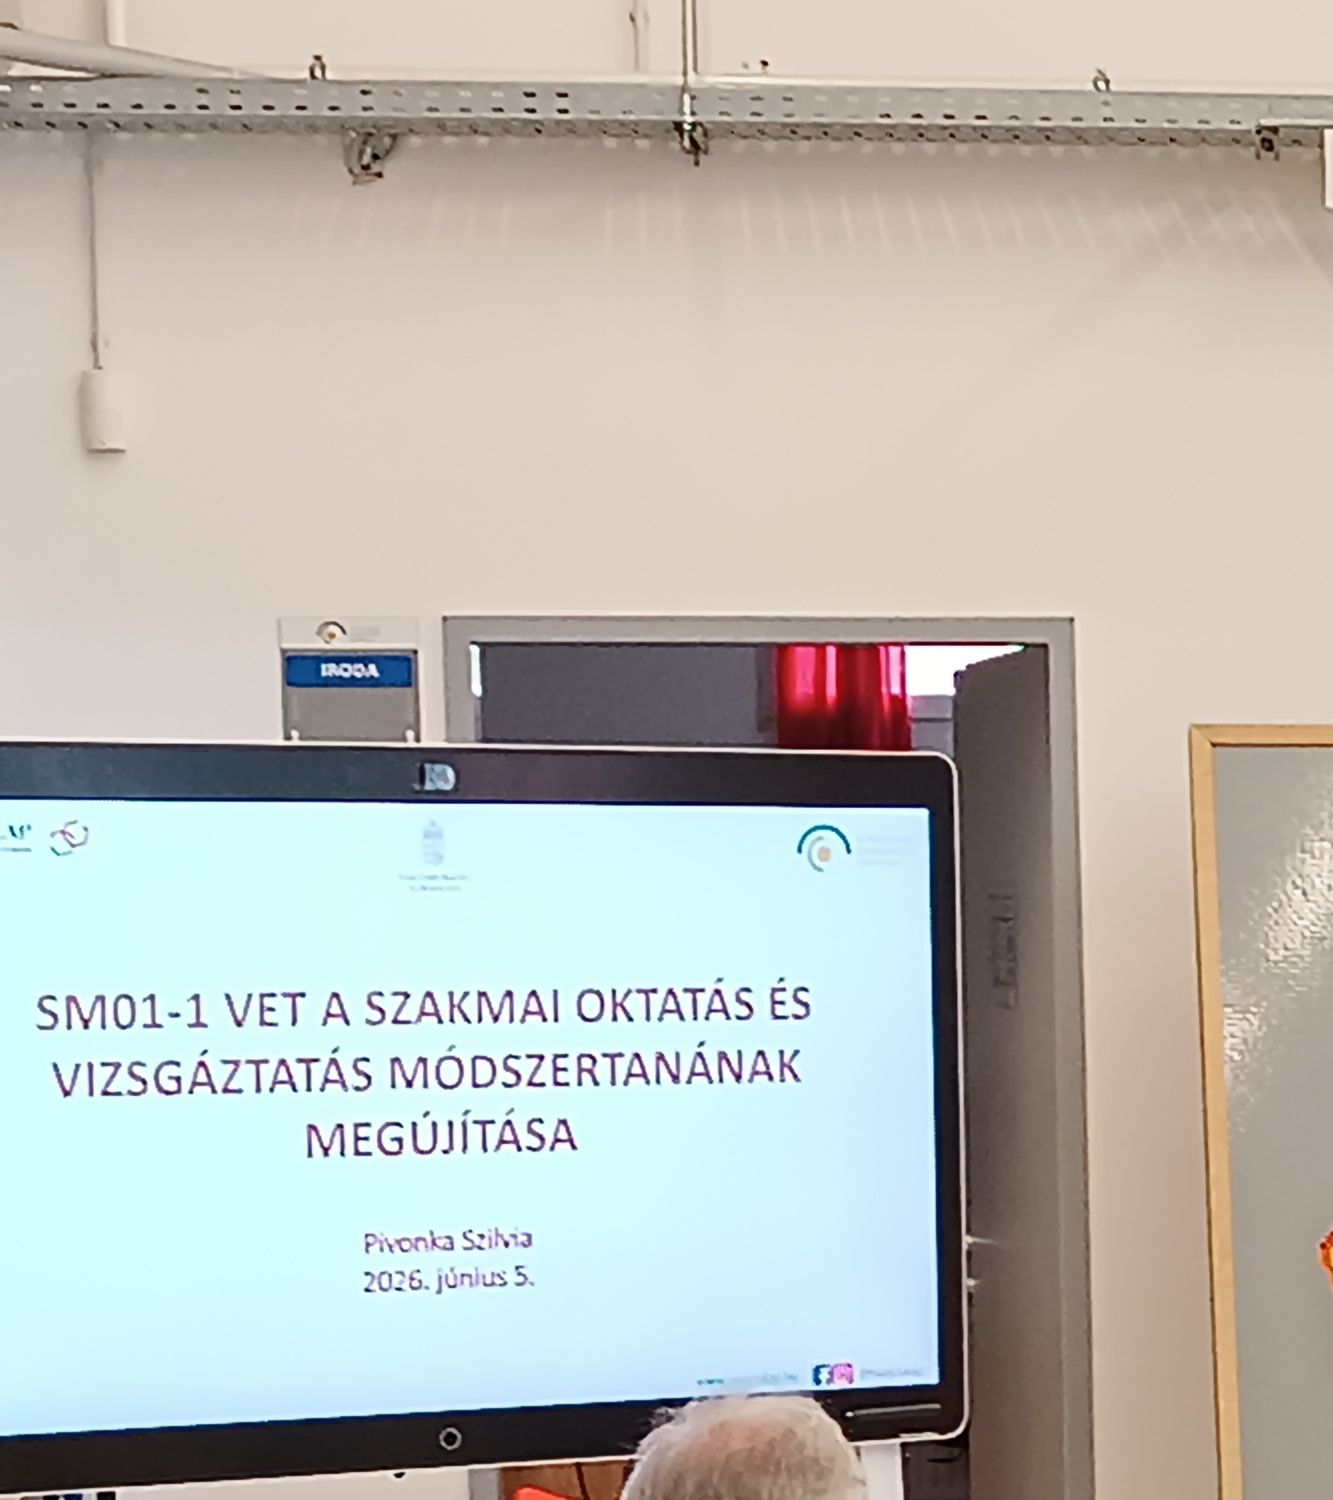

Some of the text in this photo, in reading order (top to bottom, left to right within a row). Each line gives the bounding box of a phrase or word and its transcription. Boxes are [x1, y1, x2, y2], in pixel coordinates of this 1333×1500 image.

[36, 976, 812, 1031] SM01-1 VET A SZAKMAI OKTATÁS ÉS
[51, 1040, 802, 1098] VIZSGÁZTATÁS MÓDSZERTANÁNAK
[306, 1107, 578, 1158] MEGÚJÍTÁSA
[363, 1227, 534, 1254] Pivonka Szilvia
[363, 1264, 536, 1295] 2026. június 5.
